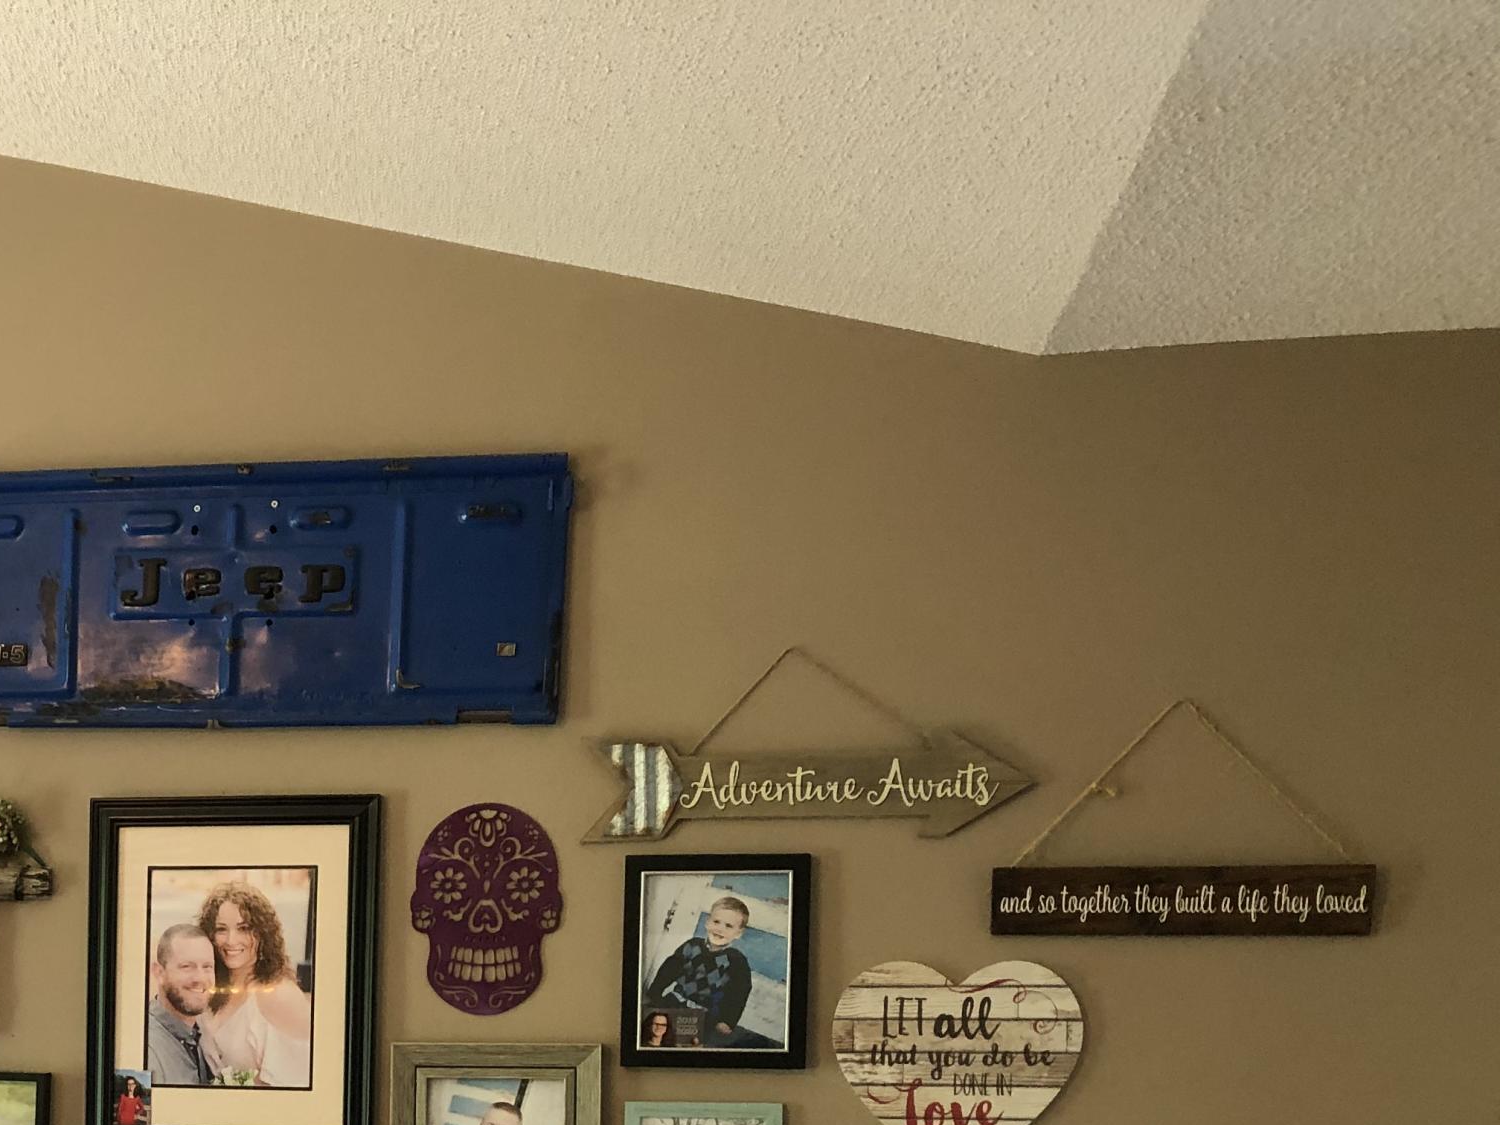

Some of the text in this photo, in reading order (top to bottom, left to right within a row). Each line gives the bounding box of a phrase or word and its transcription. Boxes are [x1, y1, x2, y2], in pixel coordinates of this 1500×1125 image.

[120, 558, 346, 607] Jeep
[679, 758, 999, 810] Adventure Awaits
[999, 884, 1368, 922] and so together they built a life they loved
[881, 995, 1000, 1040] LET all
[870, 1040, 1055, 1080] that you do be
[953, 1073, 1012, 1097] DONE IN
